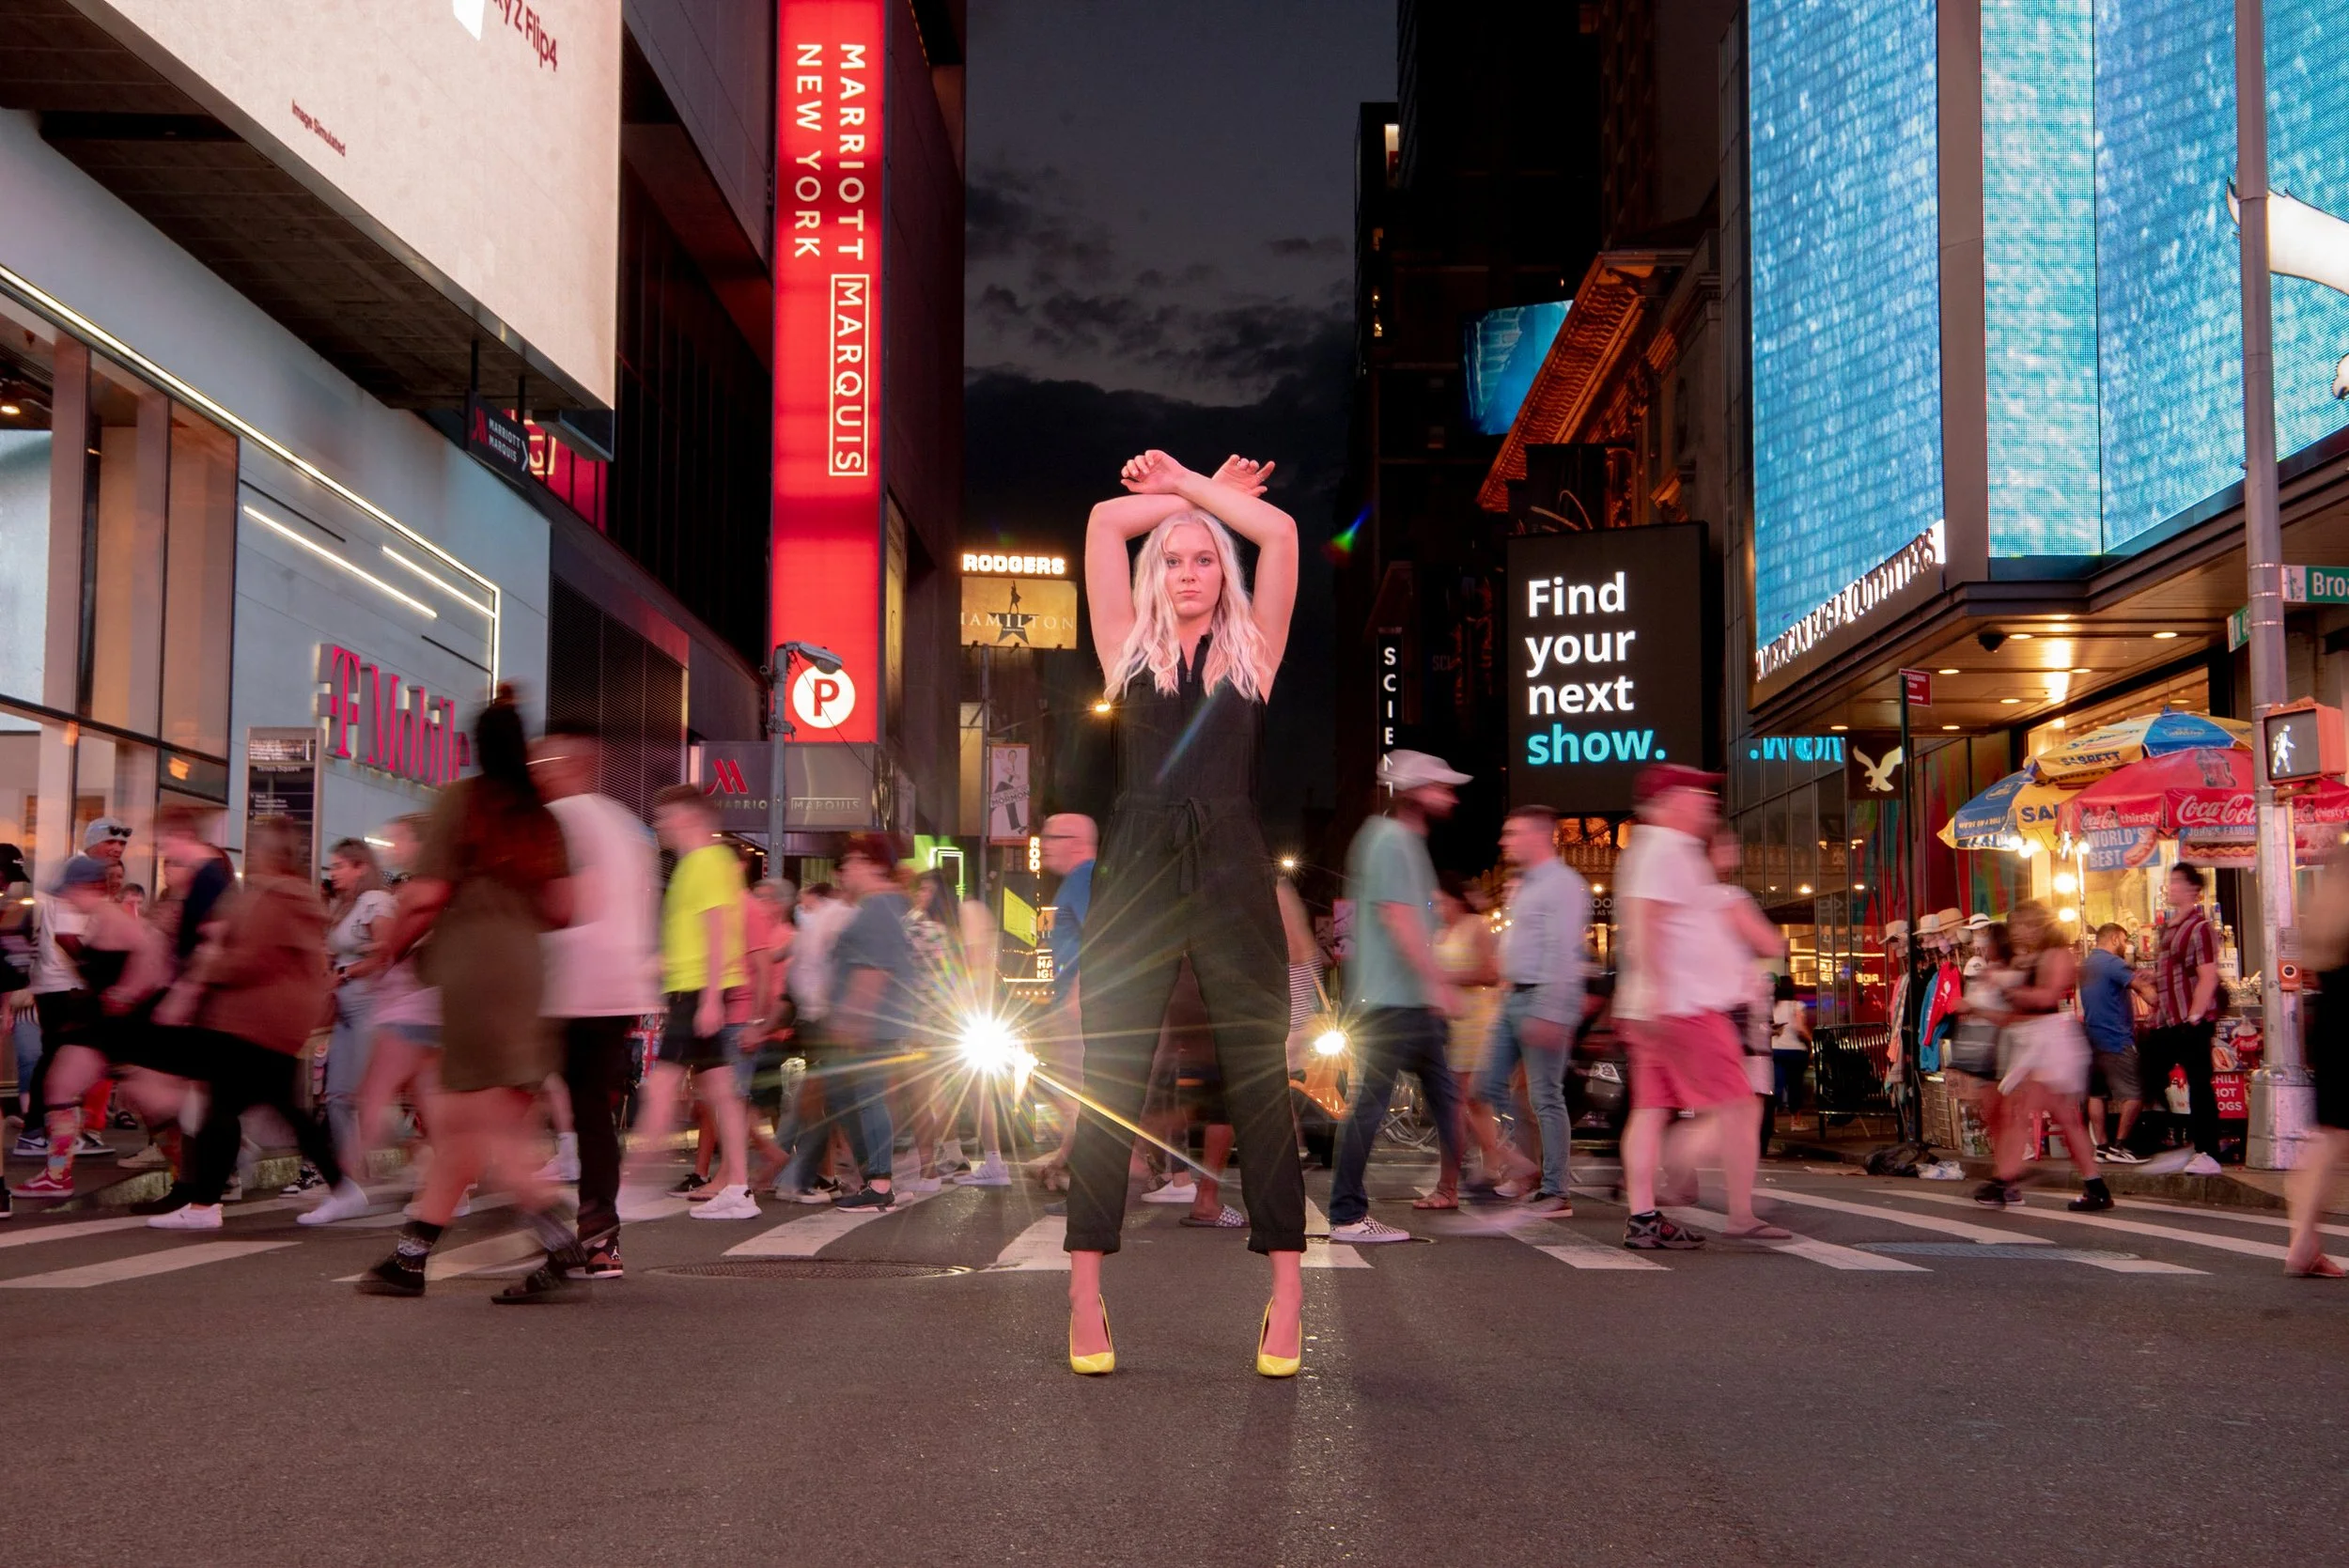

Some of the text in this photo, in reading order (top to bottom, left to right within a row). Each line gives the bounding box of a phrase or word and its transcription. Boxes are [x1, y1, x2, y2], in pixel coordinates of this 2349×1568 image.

[525, 6, 557, 72] Flip4
[794, 43, 823, 258] NEW YORK
[835, 43, 866, 470] MARRIOTT MARQUIS
[489, 417, 521, 449] MARRIOTT
[489, 434, 517, 463] MARQUIS
[962, 553, 1066, 575] RODGERS
[1528, 571, 1626, 618] Find
[2312, 571, 2349, 597] Bro
[1525, 629, 1637, 677] your
[814, 679, 839, 717] P
[1528, 675, 1635, 715] next
[1528, 722, 1666, 765] show.
[714, 800, 861, 812] MARRIO MARQUIS
[2120, 811, 2160, 824] thirsty?
[2176, 794, 2256, 825] Coca-Col
[2087, 827, 2147, 847] WORLD'S
[2223, 827, 2256, 836] FAMOU
[2089, 849, 2122, 868] BEST
[2211, 1074, 2239, 1084] HILI
[2217, 1101, 2243, 1112] OGS
